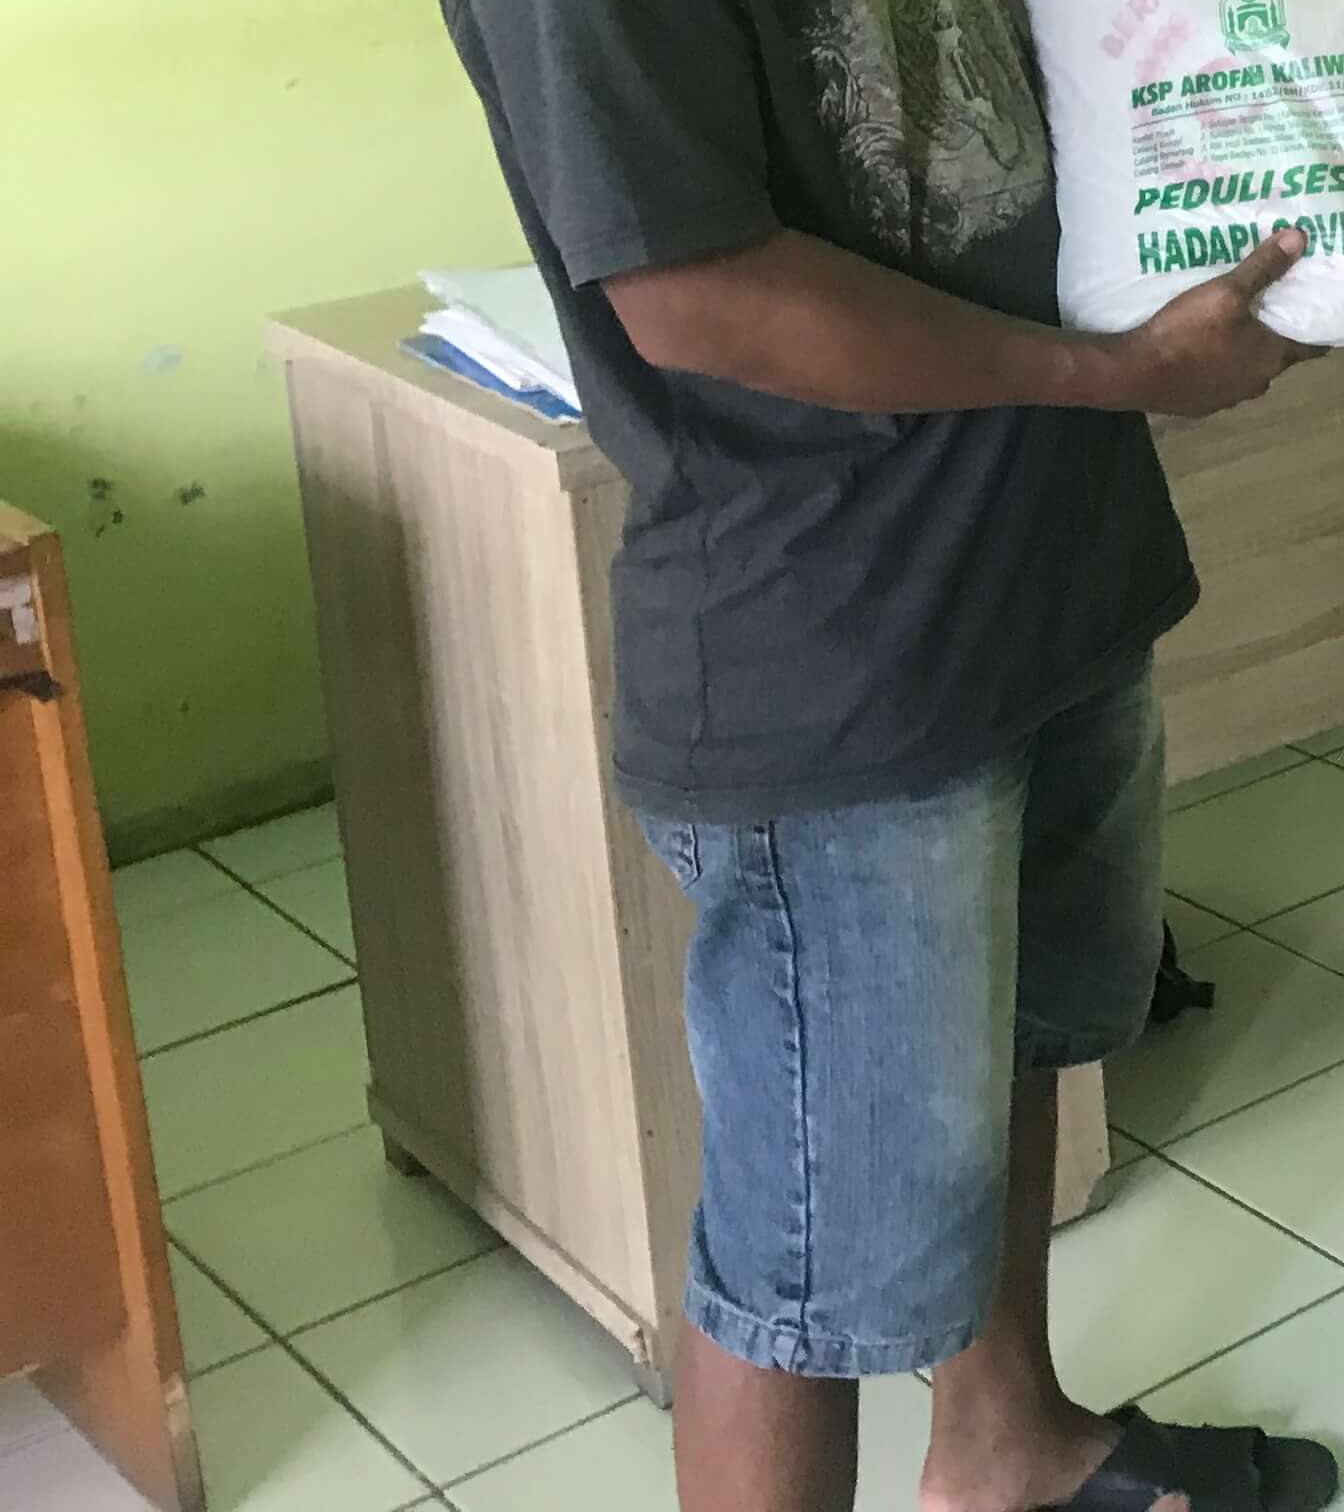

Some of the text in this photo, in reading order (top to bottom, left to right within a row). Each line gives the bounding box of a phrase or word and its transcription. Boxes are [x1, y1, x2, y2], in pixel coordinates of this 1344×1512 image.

[1131, 81, 1173, 109] KSP
[1181, 64, 1266, 97] AROFAH
[1134, 170, 1275, 216] PEDULI
[1138, 222, 1259, 274] HADAPI
